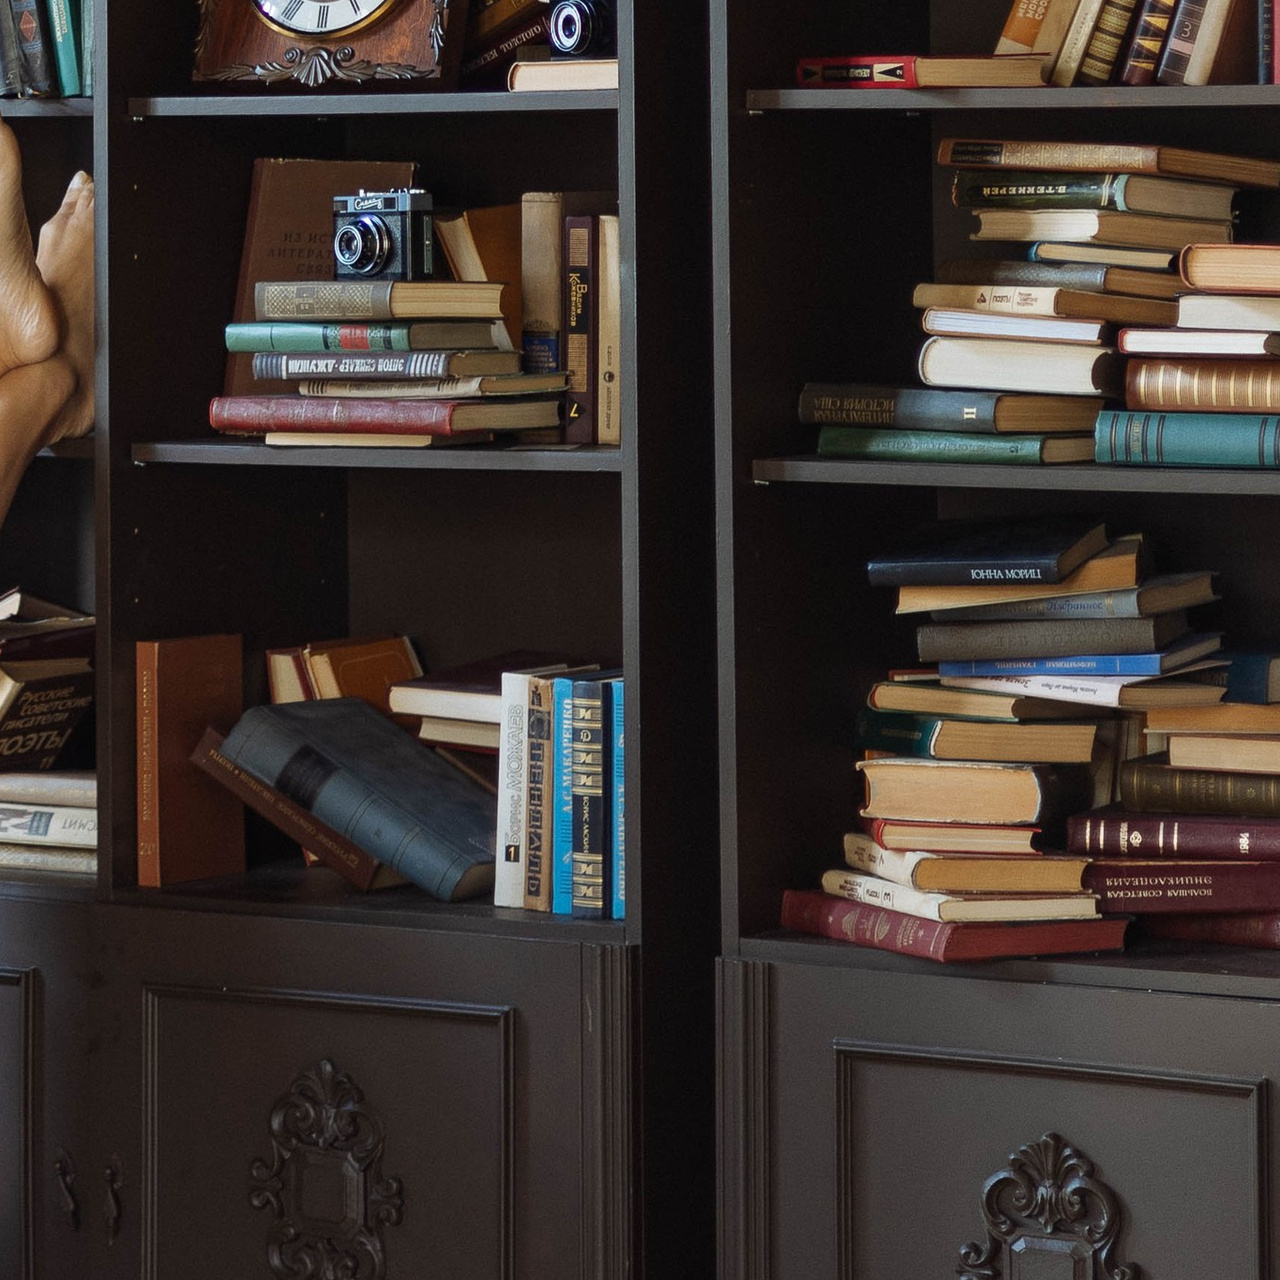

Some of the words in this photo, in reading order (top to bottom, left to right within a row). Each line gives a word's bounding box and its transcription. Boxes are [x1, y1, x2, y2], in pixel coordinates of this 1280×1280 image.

[317, 5, 329, 28] III
[498, 23, 542, 53] ТОЛСТОГО
[1181, 22, 1192, 38] 3
[982, 185, 1066, 195] В.ТЕККЕРЕЙ
[813, 395, 839, 409] США
[843, 396, 894, 413] ИСТОРИЯ
[812, 407, 893, 427] ЛИТЕРАТУРНАЯ
[963, 407, 977, 420] II
[971, 568, 1003, 579] ЮННА
[1005, 568, 1041, 579] МОРИЦ
[1046, 599, 1102, 612] Избранное
[18, 684, 76, 703] Русские
[19, 697, 92, 716] советские
[2, 711, 70, 731] писатели
[506, 704, 523, 791] МОЖАЕВ
[527, 710, 550, 899] СТЕНДАЛЬ
[1106, 875, 1211, 886] ЭНЦИКЛОПЕДИЯ
[1167, 888, 1211, 896] БОЛЬШАЯ
